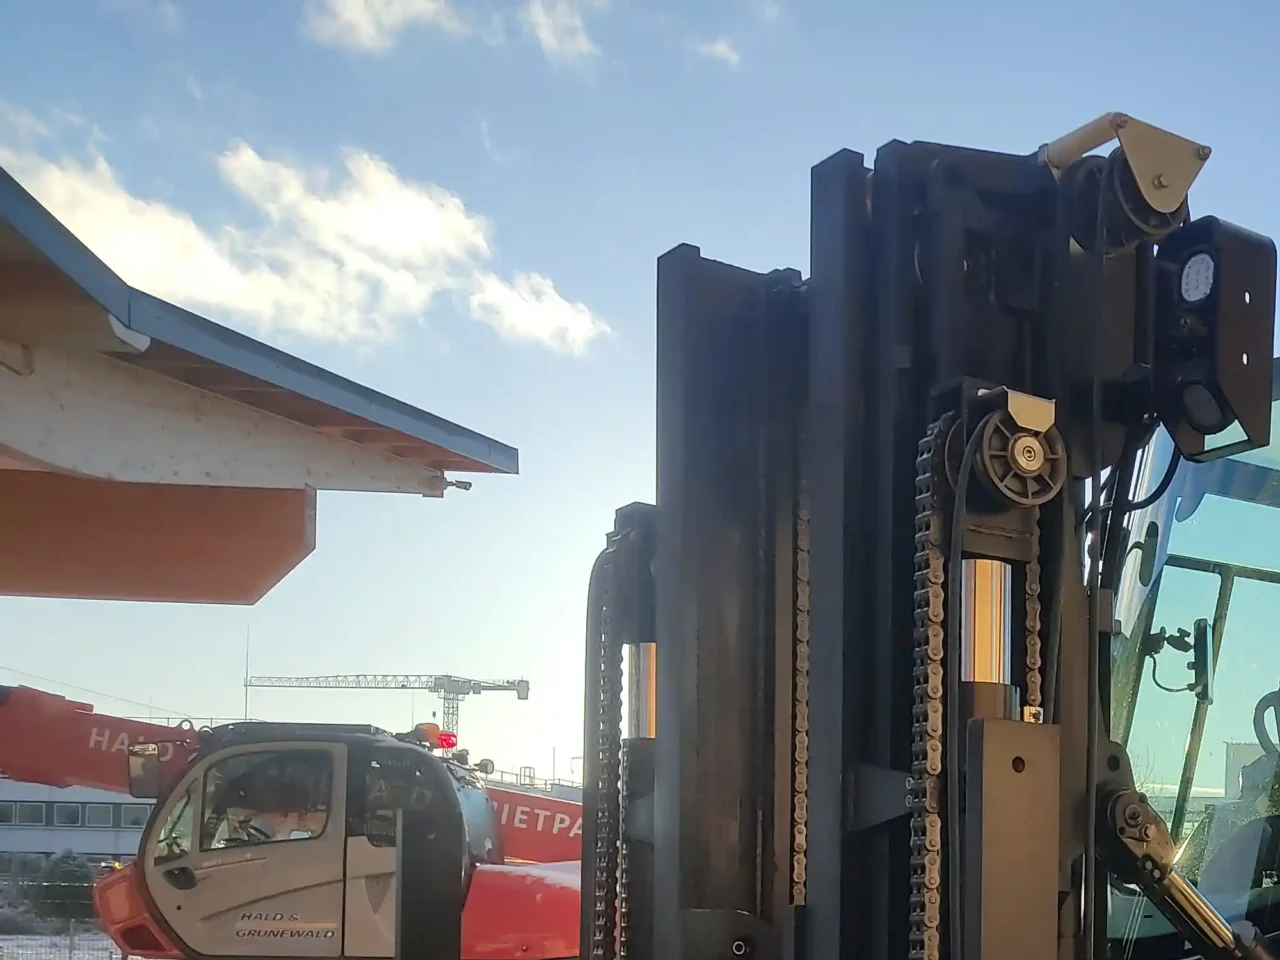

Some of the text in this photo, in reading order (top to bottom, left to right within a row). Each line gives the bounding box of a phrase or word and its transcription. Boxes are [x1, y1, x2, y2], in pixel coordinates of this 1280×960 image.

[88, 728, 174, 763] HAD
[240, 912, 284, 922] HALD
[235, 929, 336, 939] GRUNEWALD
